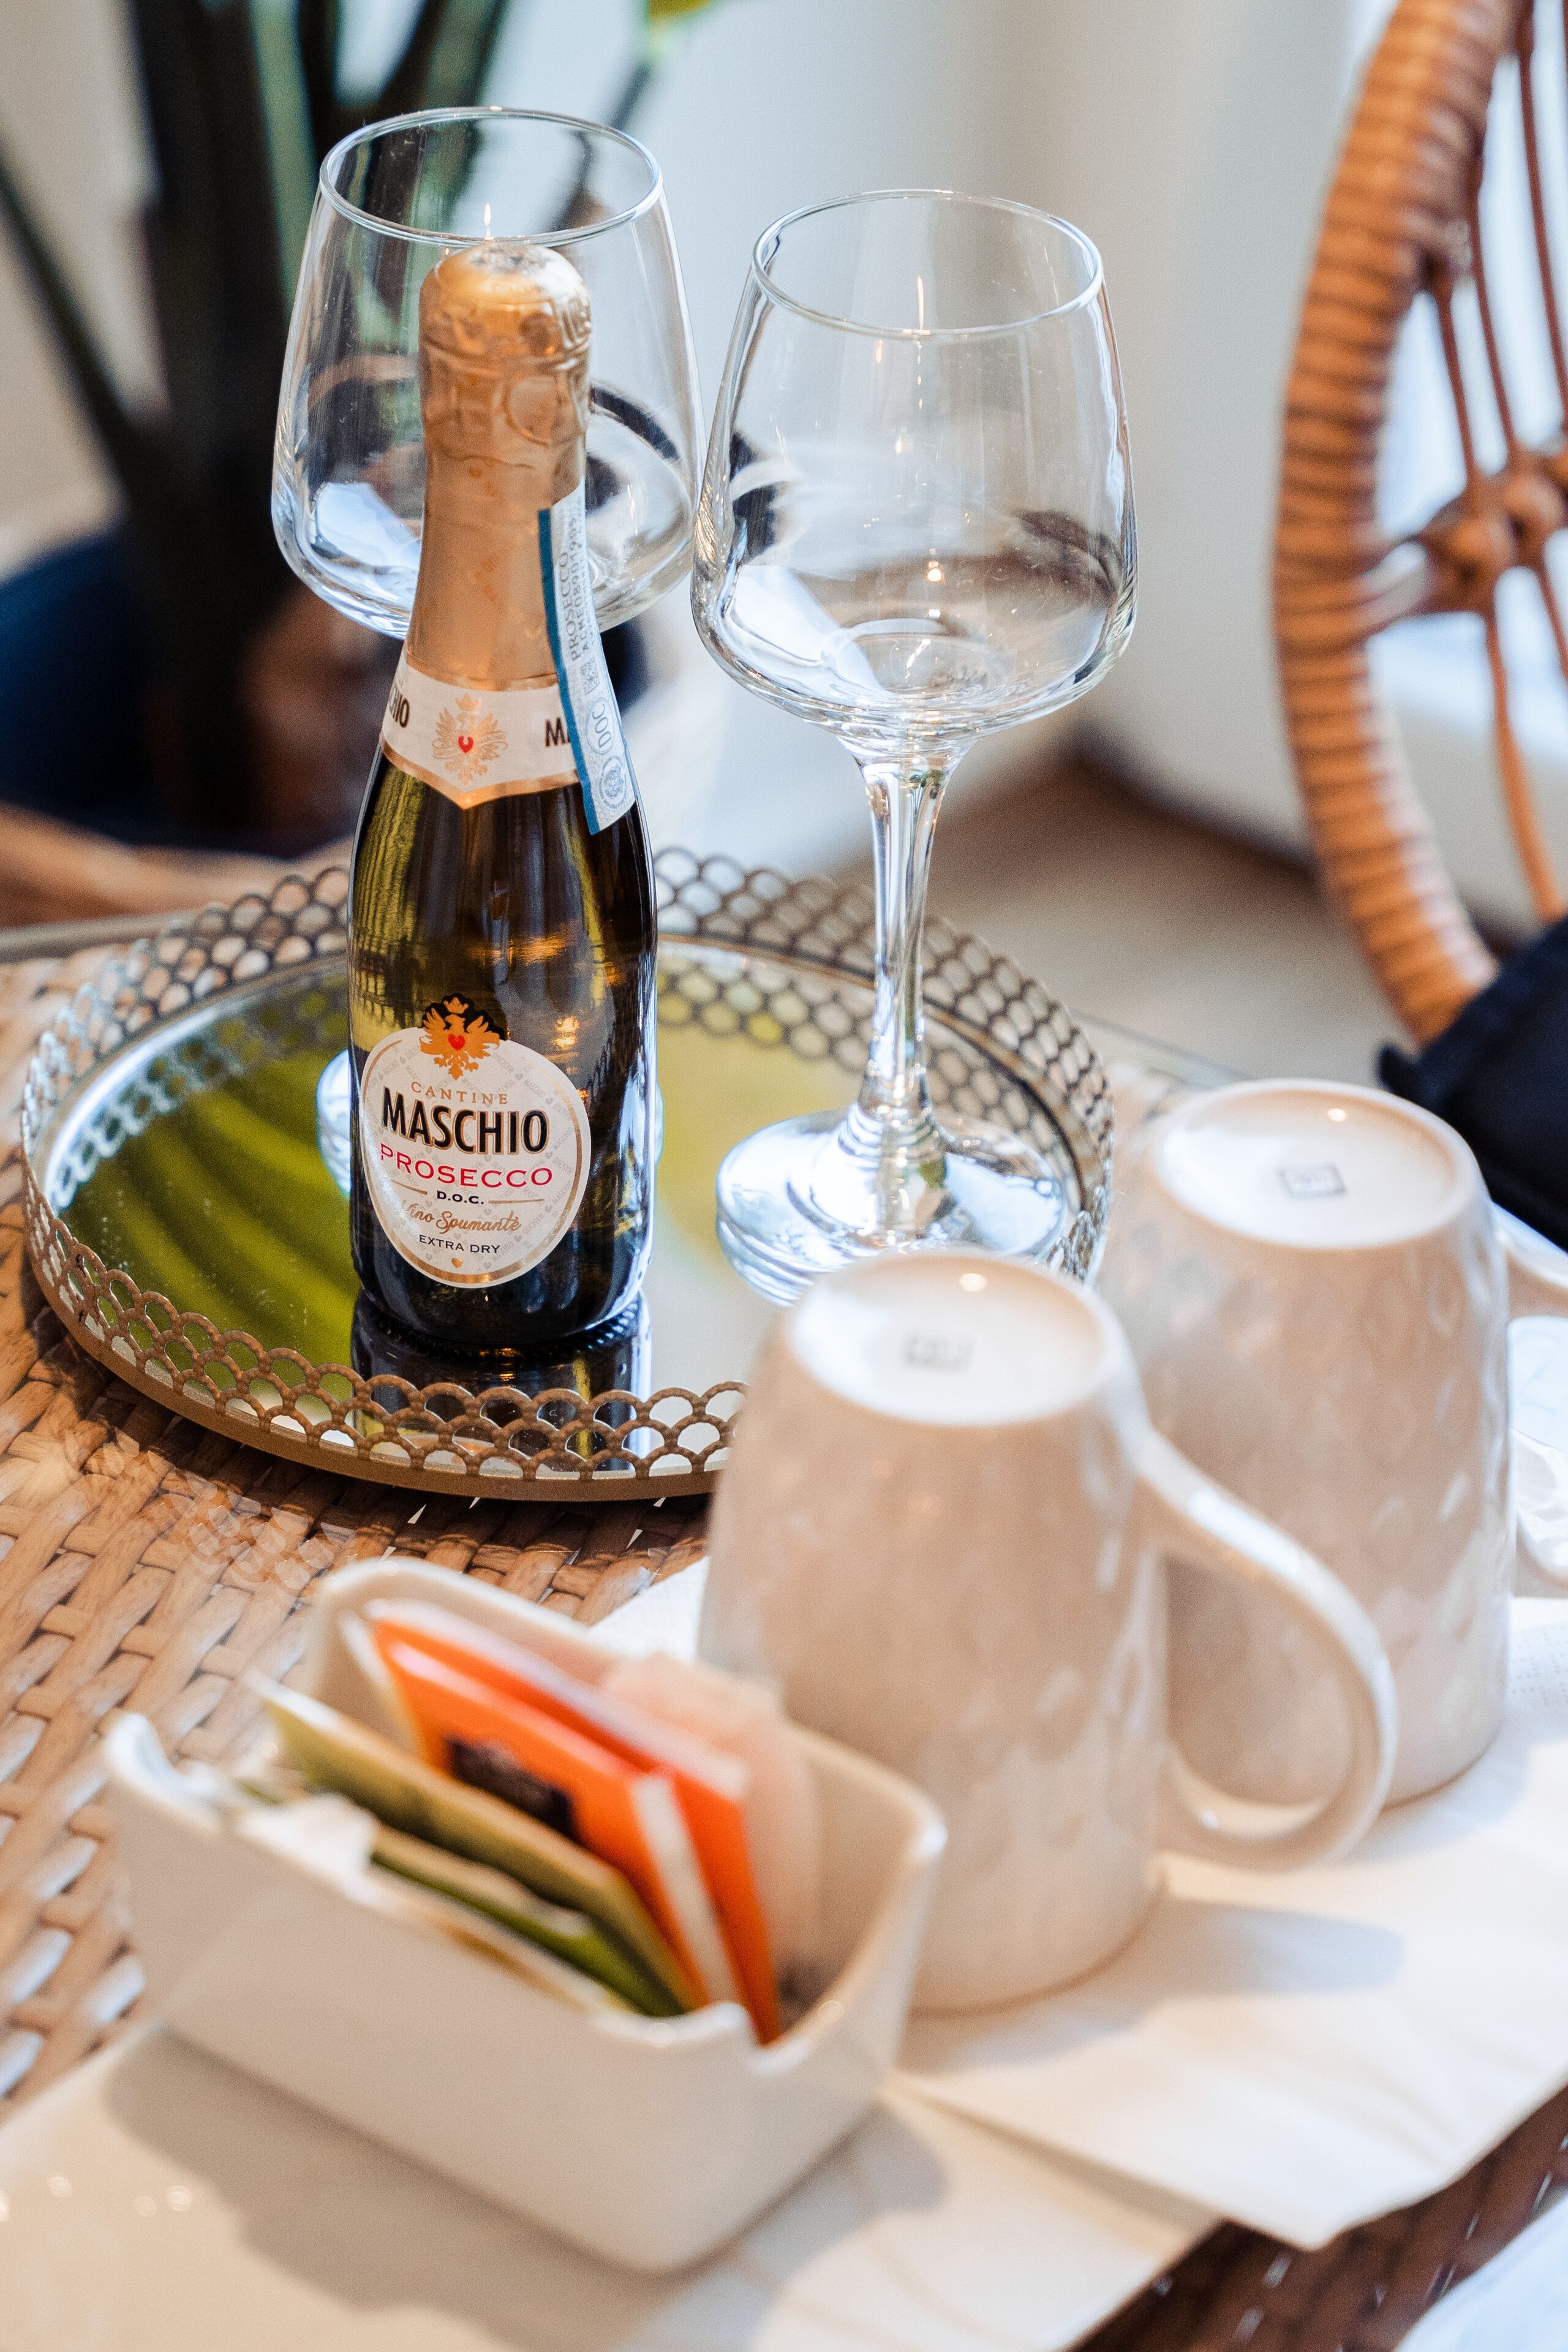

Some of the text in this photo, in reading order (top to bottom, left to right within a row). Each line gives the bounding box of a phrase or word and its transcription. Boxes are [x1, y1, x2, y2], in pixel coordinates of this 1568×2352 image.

[559, 552, 581, 662] PROSECCO
[592, 703, 612, 749] DOC
[411, 1081, 508, 1104] CANTINE
[381, 1086, 550, 1155] MASCHIO
[380, 1143, 552, 1188] PROSECCO
[437, 1190, 484, 1204] D.O.C.
[436, 1210, 522, 1234] Spumante
[419, 1234, 500, 1254] EXTRA DRY
